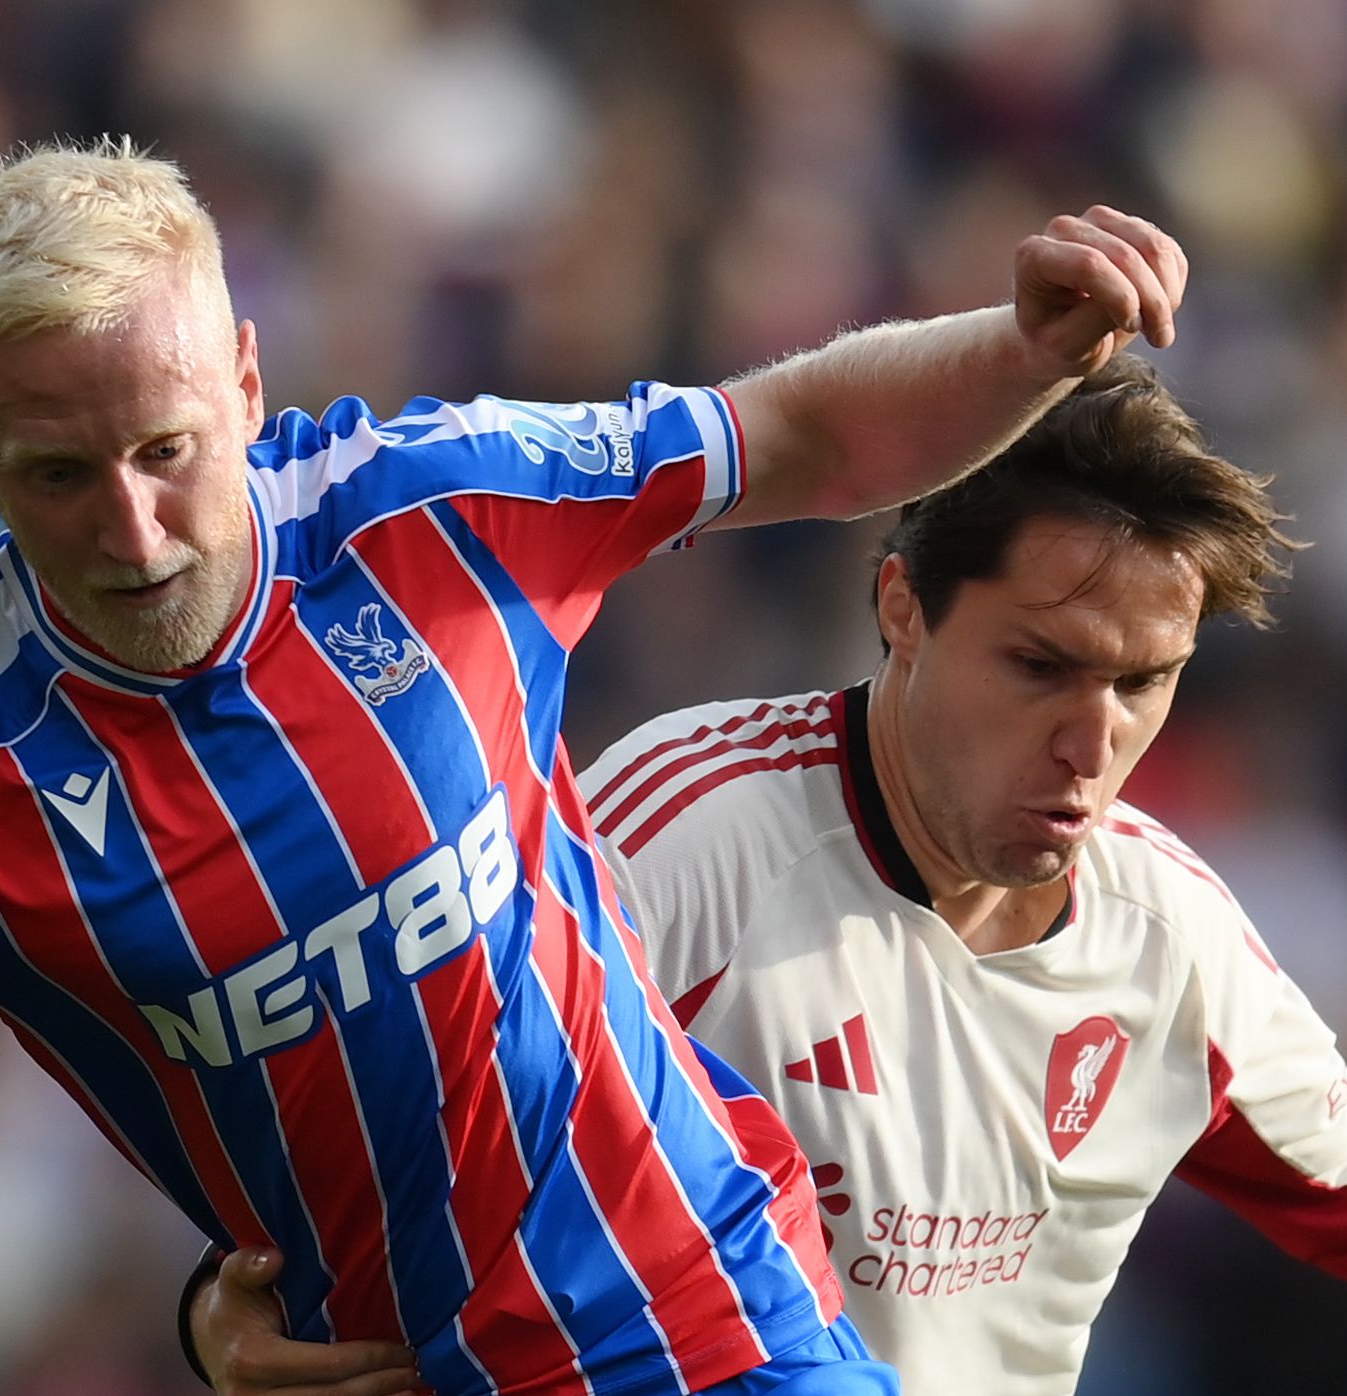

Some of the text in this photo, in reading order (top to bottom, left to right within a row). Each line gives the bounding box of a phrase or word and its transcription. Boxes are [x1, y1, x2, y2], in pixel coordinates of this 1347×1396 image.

[138, 790, 518, 1066] NET88
[867, 1204, 1050, 1250] standard
[849, 1243, 1033, 1297] chartered
